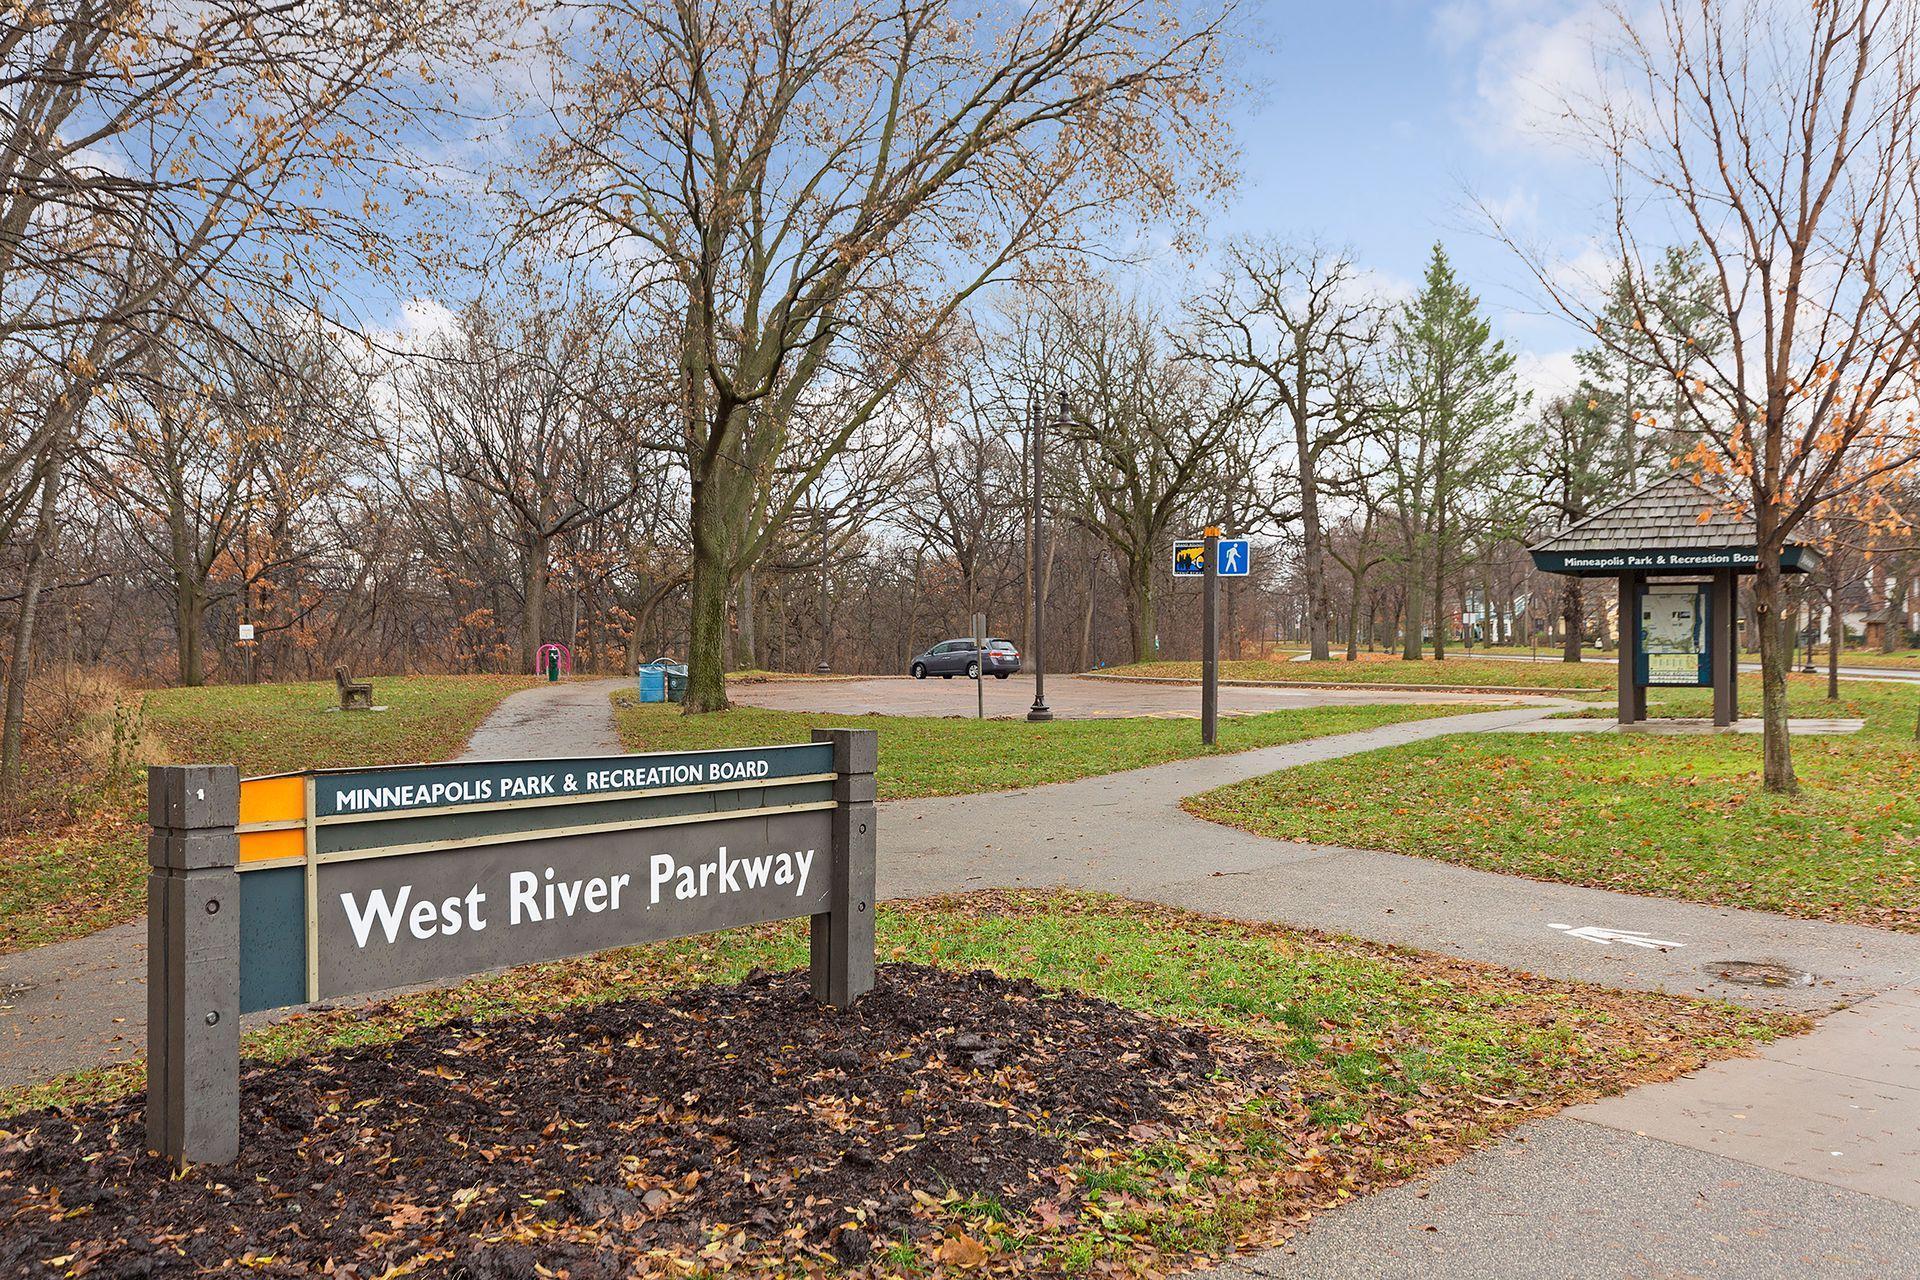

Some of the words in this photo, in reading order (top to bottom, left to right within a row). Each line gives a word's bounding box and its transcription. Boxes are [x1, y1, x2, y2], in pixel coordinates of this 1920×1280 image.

[1564, 557, 1624, 568] Minneapolis
[1628, 556, 1653, 566] Park
[1656, 555, 1666, 565] &
[1670, 554, 1730, 564] Recreation
[1733, 553, 1759, 563] Boar
[336, 779, 492, 811] MINNEAPOLIS
[500, 774, 555, 798] PARK
[562, 773, 579, 792] &
[586, 764, 703, 790] RECREATION
[709, 760, 769, 781] BOARD
[339, 883, 487, 949] West
[509, 866, 631, 926] River
[650, 846, 815, 905] Parkway
